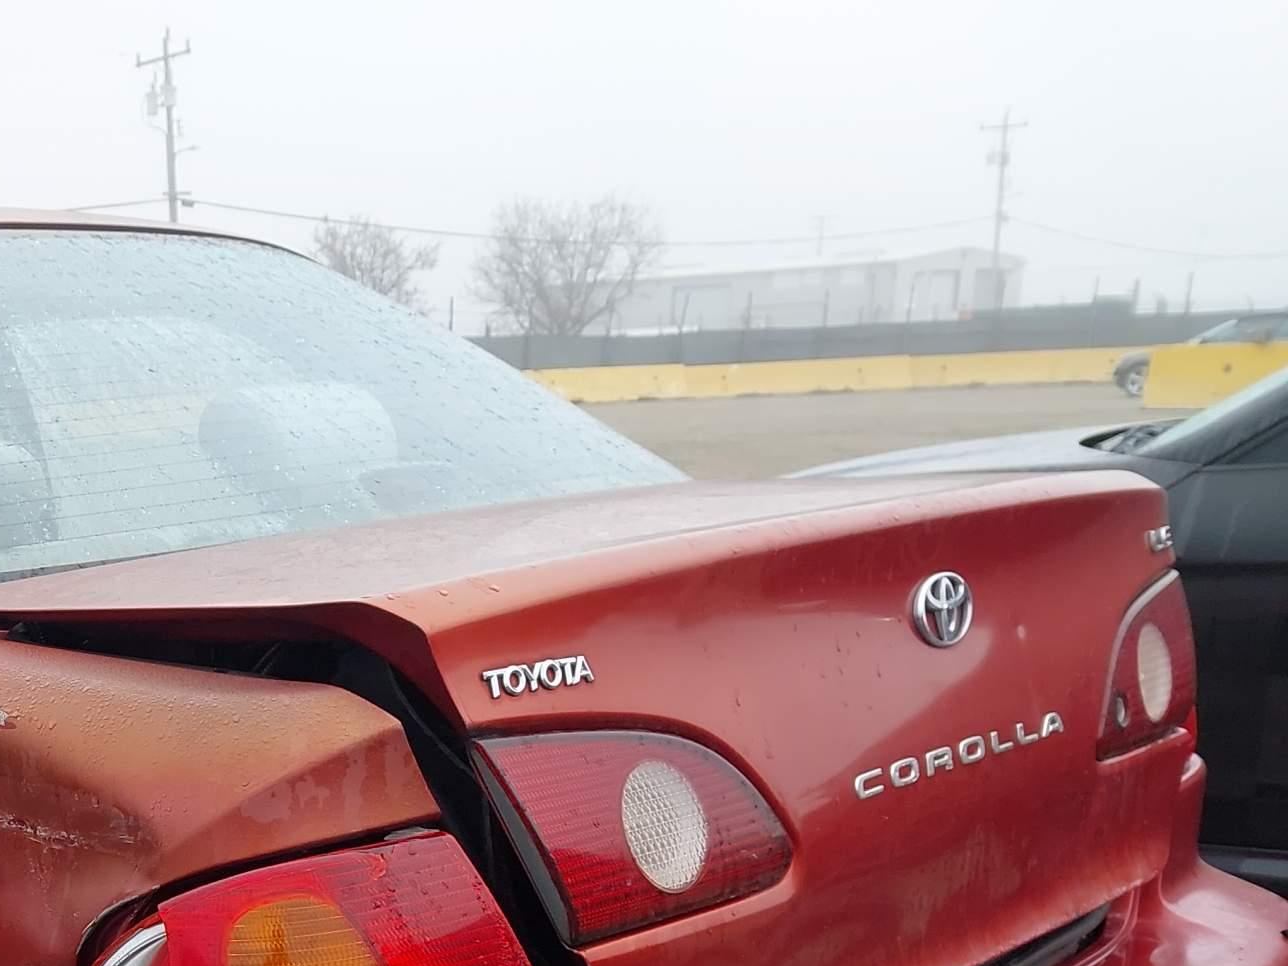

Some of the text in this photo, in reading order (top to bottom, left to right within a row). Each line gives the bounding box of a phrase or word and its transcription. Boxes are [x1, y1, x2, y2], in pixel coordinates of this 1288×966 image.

[1146, 525, 1173, 551] LE
[481, 655, 594, 699] TOYOTA
[854, 711, 1064, 800] COROLLA
